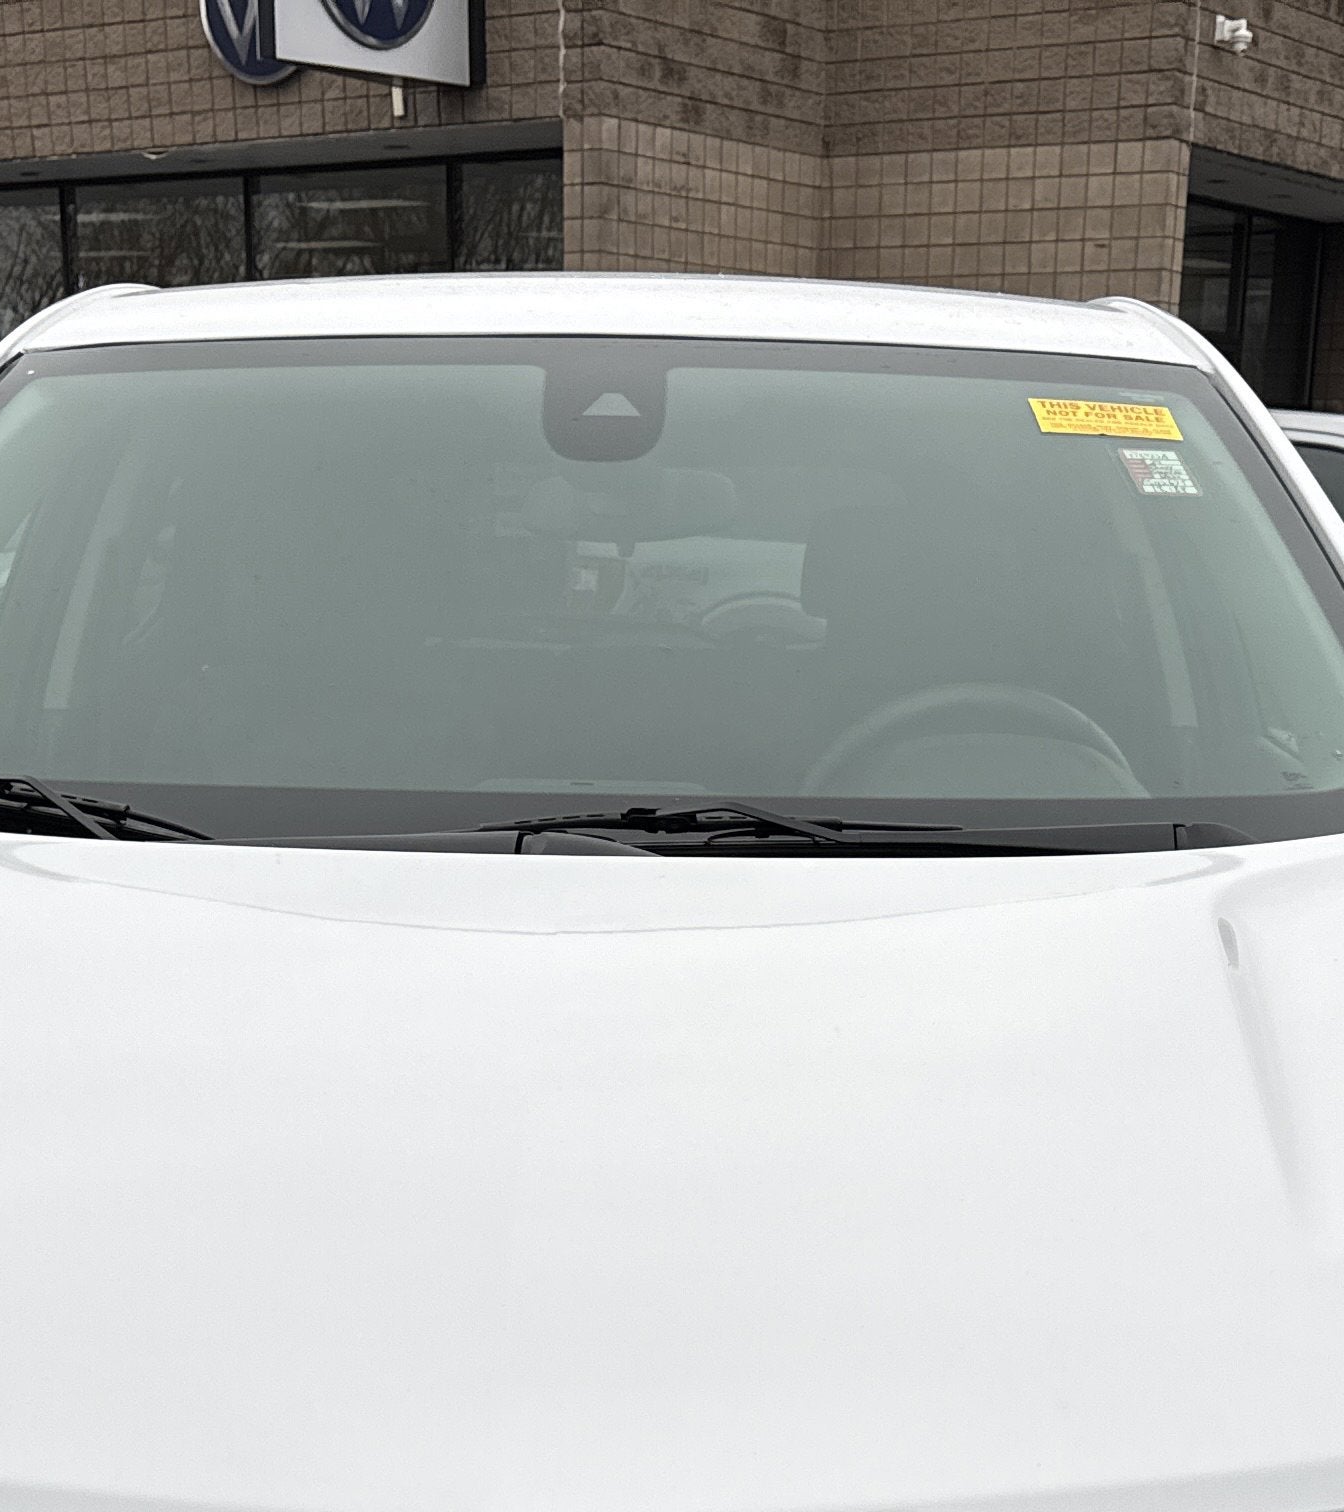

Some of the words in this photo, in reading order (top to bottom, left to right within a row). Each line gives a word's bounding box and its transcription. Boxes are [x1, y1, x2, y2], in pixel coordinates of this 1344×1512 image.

[1037, 401, 1081, 411] THIS
[1085, 403, 1166, 416] VEHICLE
[1046, 409, 1078, 418] NOT
[1084, 411, 1119, 420] FOR
[1124, 415, 1166, 424] SALE
